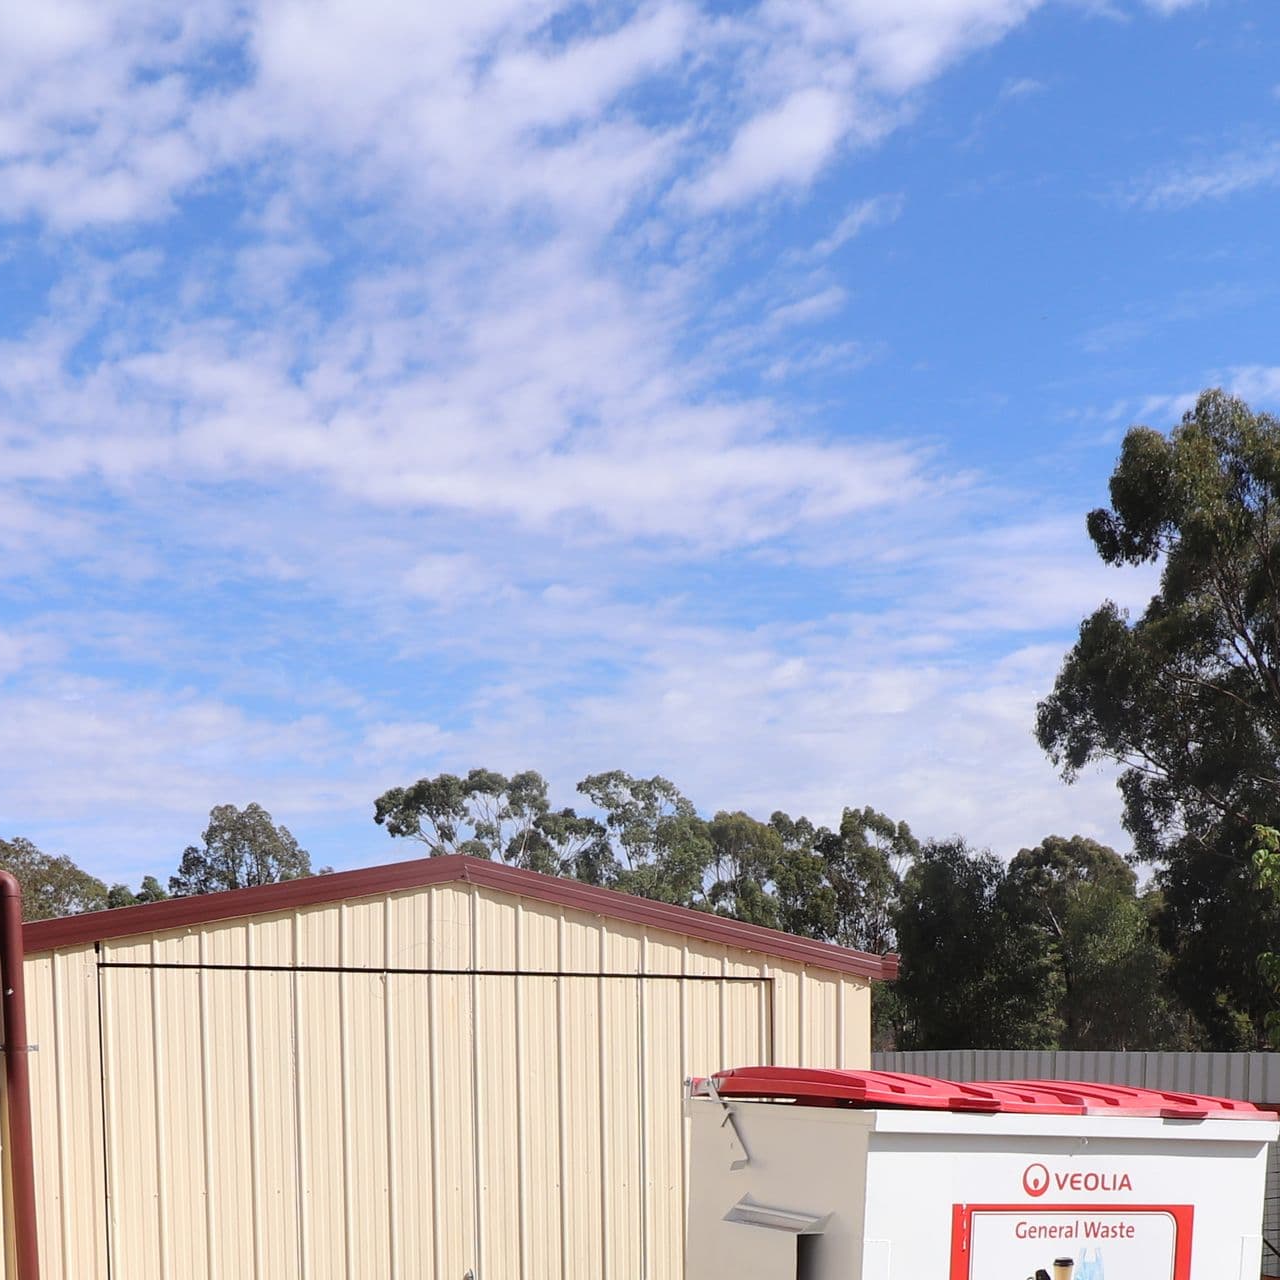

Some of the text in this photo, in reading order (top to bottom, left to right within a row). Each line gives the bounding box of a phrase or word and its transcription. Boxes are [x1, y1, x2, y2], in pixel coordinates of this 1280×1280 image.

[1055, 1172, 1133, 1191] VEOLIA
[1015, 1220, 1135, 1239] General Waste
